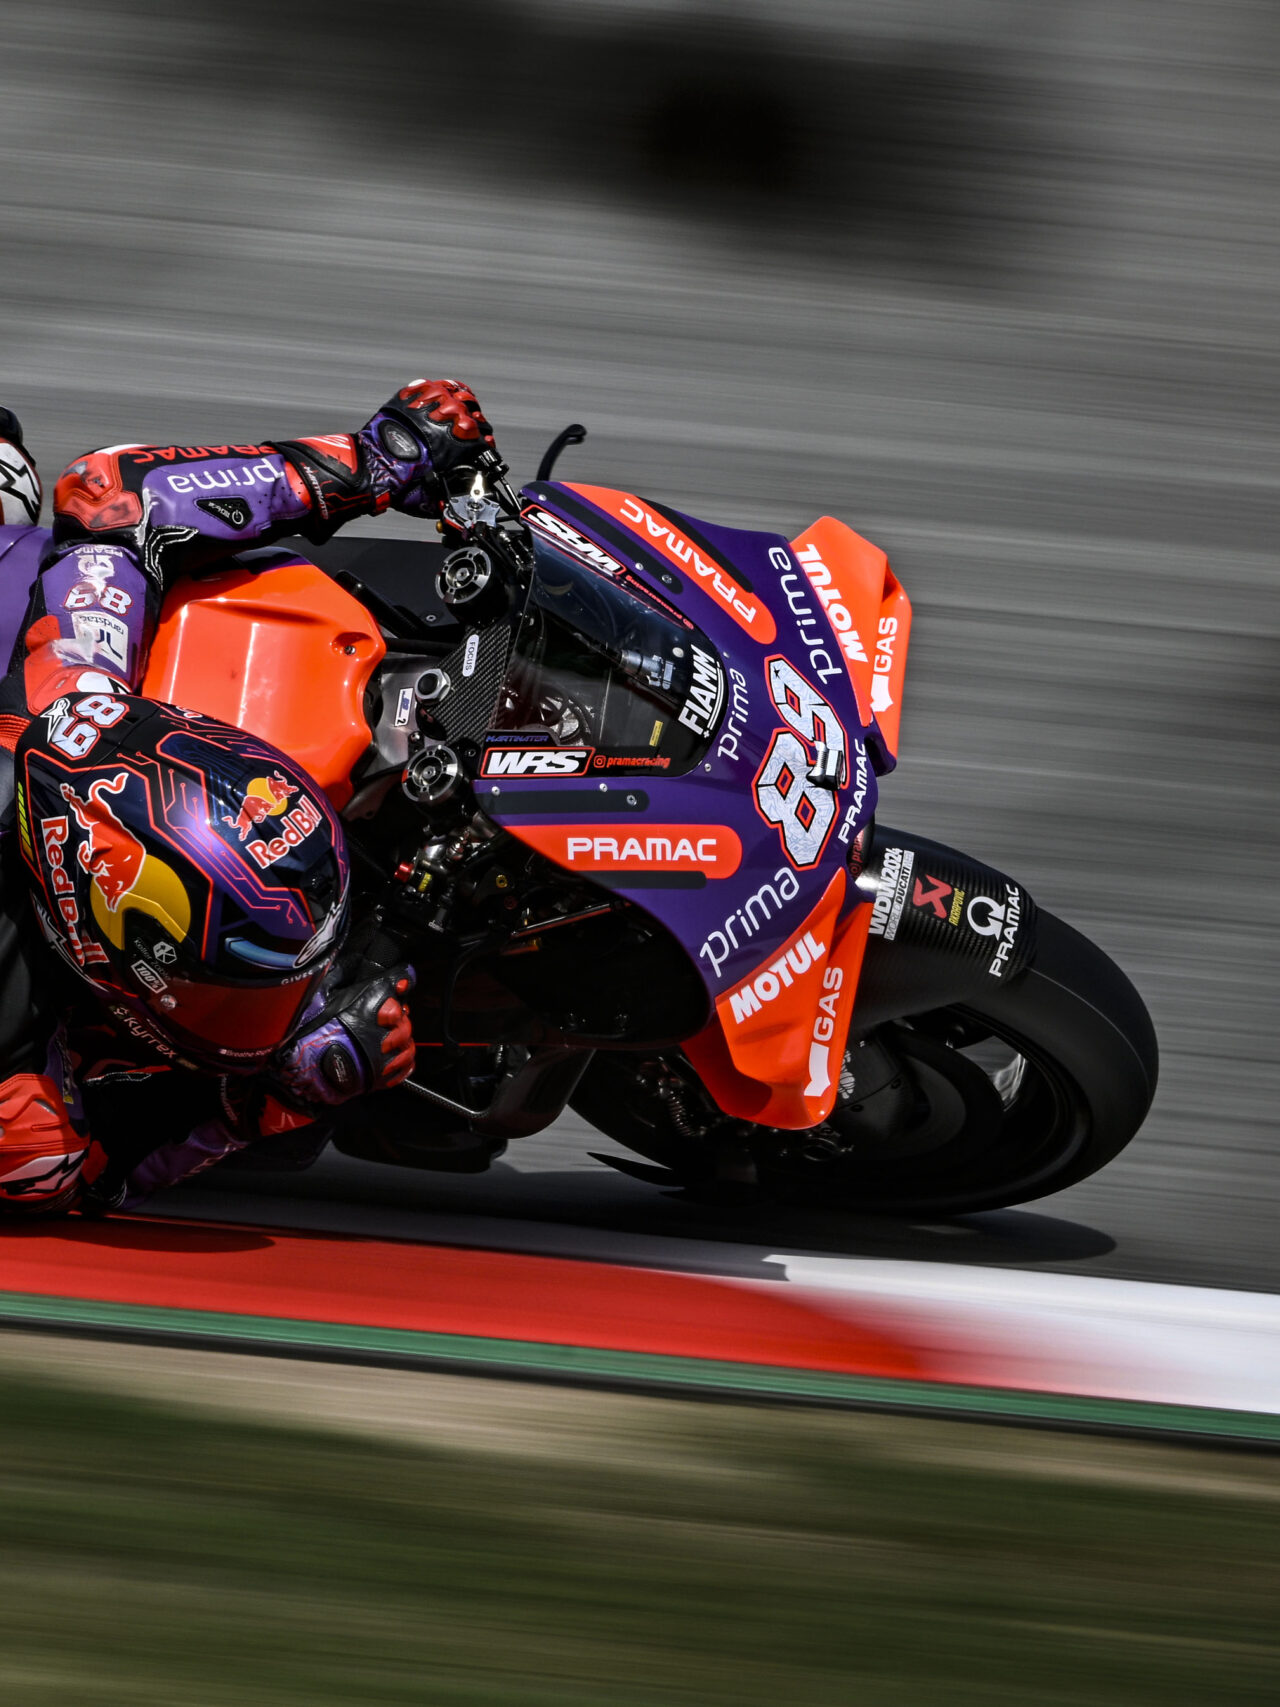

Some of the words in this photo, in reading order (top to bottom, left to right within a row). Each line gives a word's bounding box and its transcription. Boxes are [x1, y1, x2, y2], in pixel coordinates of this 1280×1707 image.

[166, 457, 284, 493] prima
[528, 510, 622, 575] WRS
[621, 499, 757, 623] PRAMAC
[64, 582, 133, 617] 89
[768, 547, 843, 685] prima
[795, 543, 869, 663] MOTUL
[465, 641, 476, 671] FOCUS
[874, 616, 899, 675] GAS
[677, 645, 719, 736] FIAMM
[717, 667, 751, 762] prima
[50, 695, 129, 758] 89
[486, 751, 588, 774] WRS
[606, 754, 671, 769] pramacracing
[838, 738, 867, 845] PRAMAC
[40, 816, 75, 895] Red
[245, 816, 305, 869] Red
[566, 837, 718, 862] PRAMAC
[868, 847, 903, 935] WDW2024
[895, 866, 910, 905] DUCATI
[699, 867, 800, 979] prima
[989, 884, 1021, 978] PRAMAC
[136, 965, 165, 990] 100%
[729, 930, 827, 1024] MOTUL
[813, 967, 844, 1041] GAS
